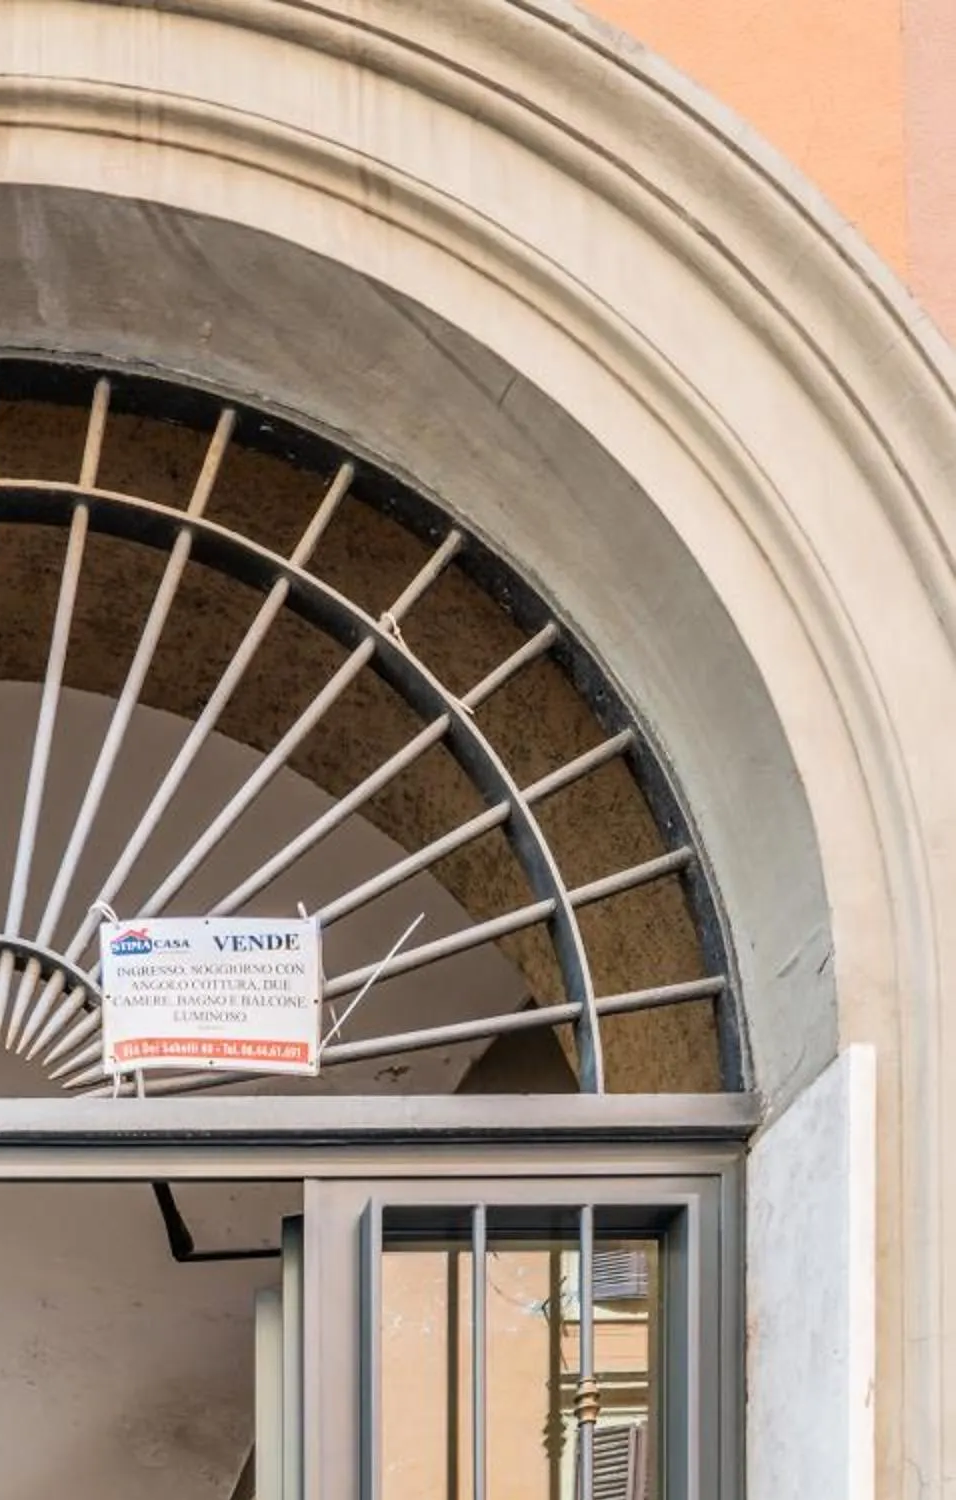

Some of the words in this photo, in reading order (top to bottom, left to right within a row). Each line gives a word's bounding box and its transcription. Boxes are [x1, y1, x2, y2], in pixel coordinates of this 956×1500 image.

[153, 938, 191, 949] CASA
[213, 933, 301, 953] VENDE
[191, 963, 273, 976] SOGGIORNO
[275, 963, 305, 975] CON
[131, 979, 189, 991] ANGOLO
[263, 979, 291, 991] DUE
[176, 994, 227, 1007] BAGNO
